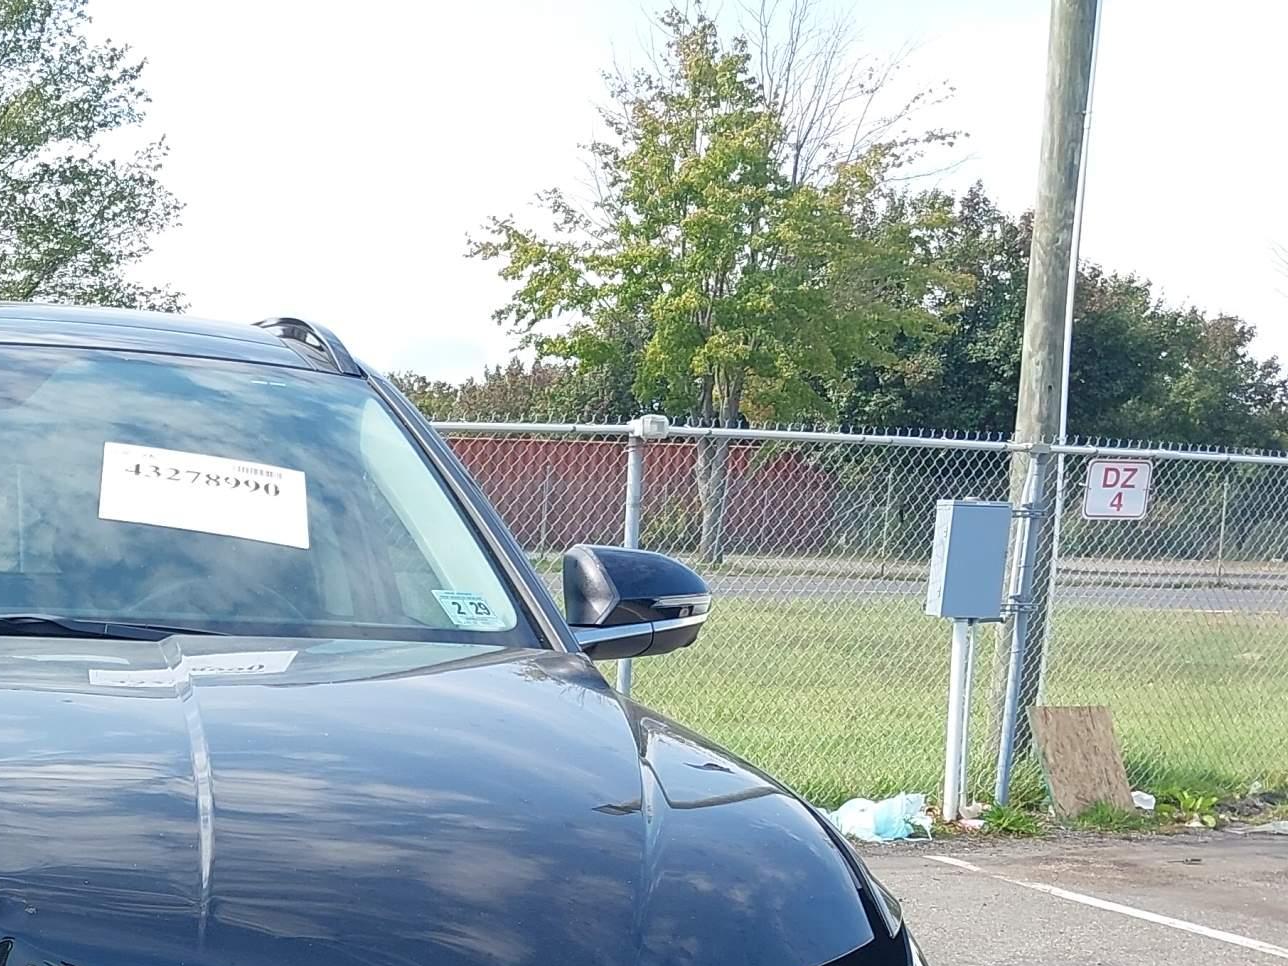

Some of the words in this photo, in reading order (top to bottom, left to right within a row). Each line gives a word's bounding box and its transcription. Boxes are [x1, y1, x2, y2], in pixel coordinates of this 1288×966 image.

[125, 463, 280, 497] 43278990
[1102, 467, 1138, 489] DZ
[1109, 491, 1123, 512] 4
[451, 601, 466, 616] 2
[469, 601, 491, 616] 29
